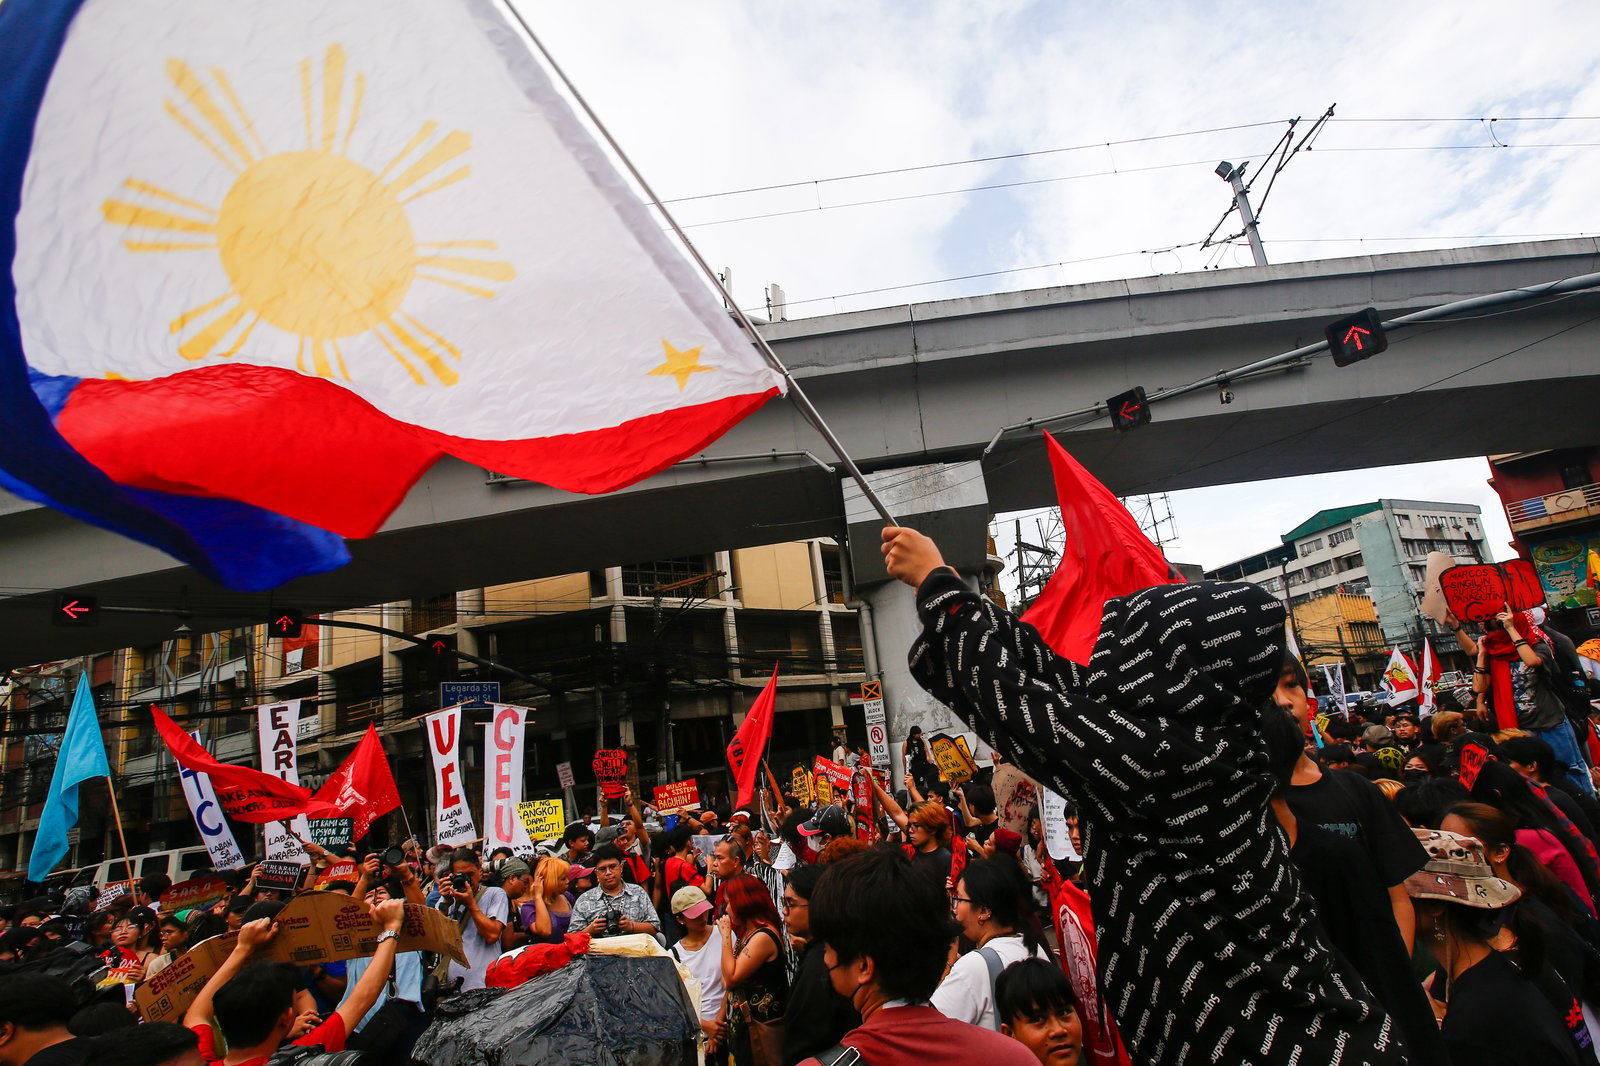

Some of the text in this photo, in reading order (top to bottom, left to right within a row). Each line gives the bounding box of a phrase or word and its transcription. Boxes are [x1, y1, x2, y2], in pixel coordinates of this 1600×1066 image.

[1450, 569, 1488, 579] MARCOS
[1160, 597, 1197, 618] Supreme
[1206, 605, 1247, 622] Supreme
[1260, 600, 1281, 611] reme
[1120, 621, 1149, 646] Supreme
[1159, 618, 1192, 644] Supreme
[1201, 630, 1242, 649] Supreme
[958, 631, 967, 671] Supreme
[1119, 649, 1153, 672] Supreme
[445, 684, 480, 693] Legarda
[1117, 672, 1154, 694] Supreme
[1167, 667, 1198, 695] Supreme
[993, 679, 1008, 720] Supreme
[1019, 694, 1035, 733] Supreme
[1078, 715, 1114, 743] Supreme
[1108, 710, 1147, 739] Supreme
[873, 745, 884, 754] NO
[1092, 758, 1130, 791] Supreme
[665, 782, 688, 791] BULOK
[671, 785, 698, 796] SISTEMA
[519, 801, 536, 809] AHAT
[657, 793, 691, 810] BAGUHIN!
[520, 806, 559, 819] ANGKOT
[526, 817, 547, 826] DAPAT
[1165, 804, 1209, 827] Supreme
[320, 819, 338, 827] KAMI
[340, 827, 350, 835] AT
[448, 819, 460, 828] SA
[209, 838, 233, 854] LABAN
[220, 848, 231, 859] SA
[284, 841, 295, 849] SA
[1215, 838, 1252, 866] Supreme
[1093, 849, 1108, 887] Supreme
[1260, 1013, 1284, 1056] Supreme
